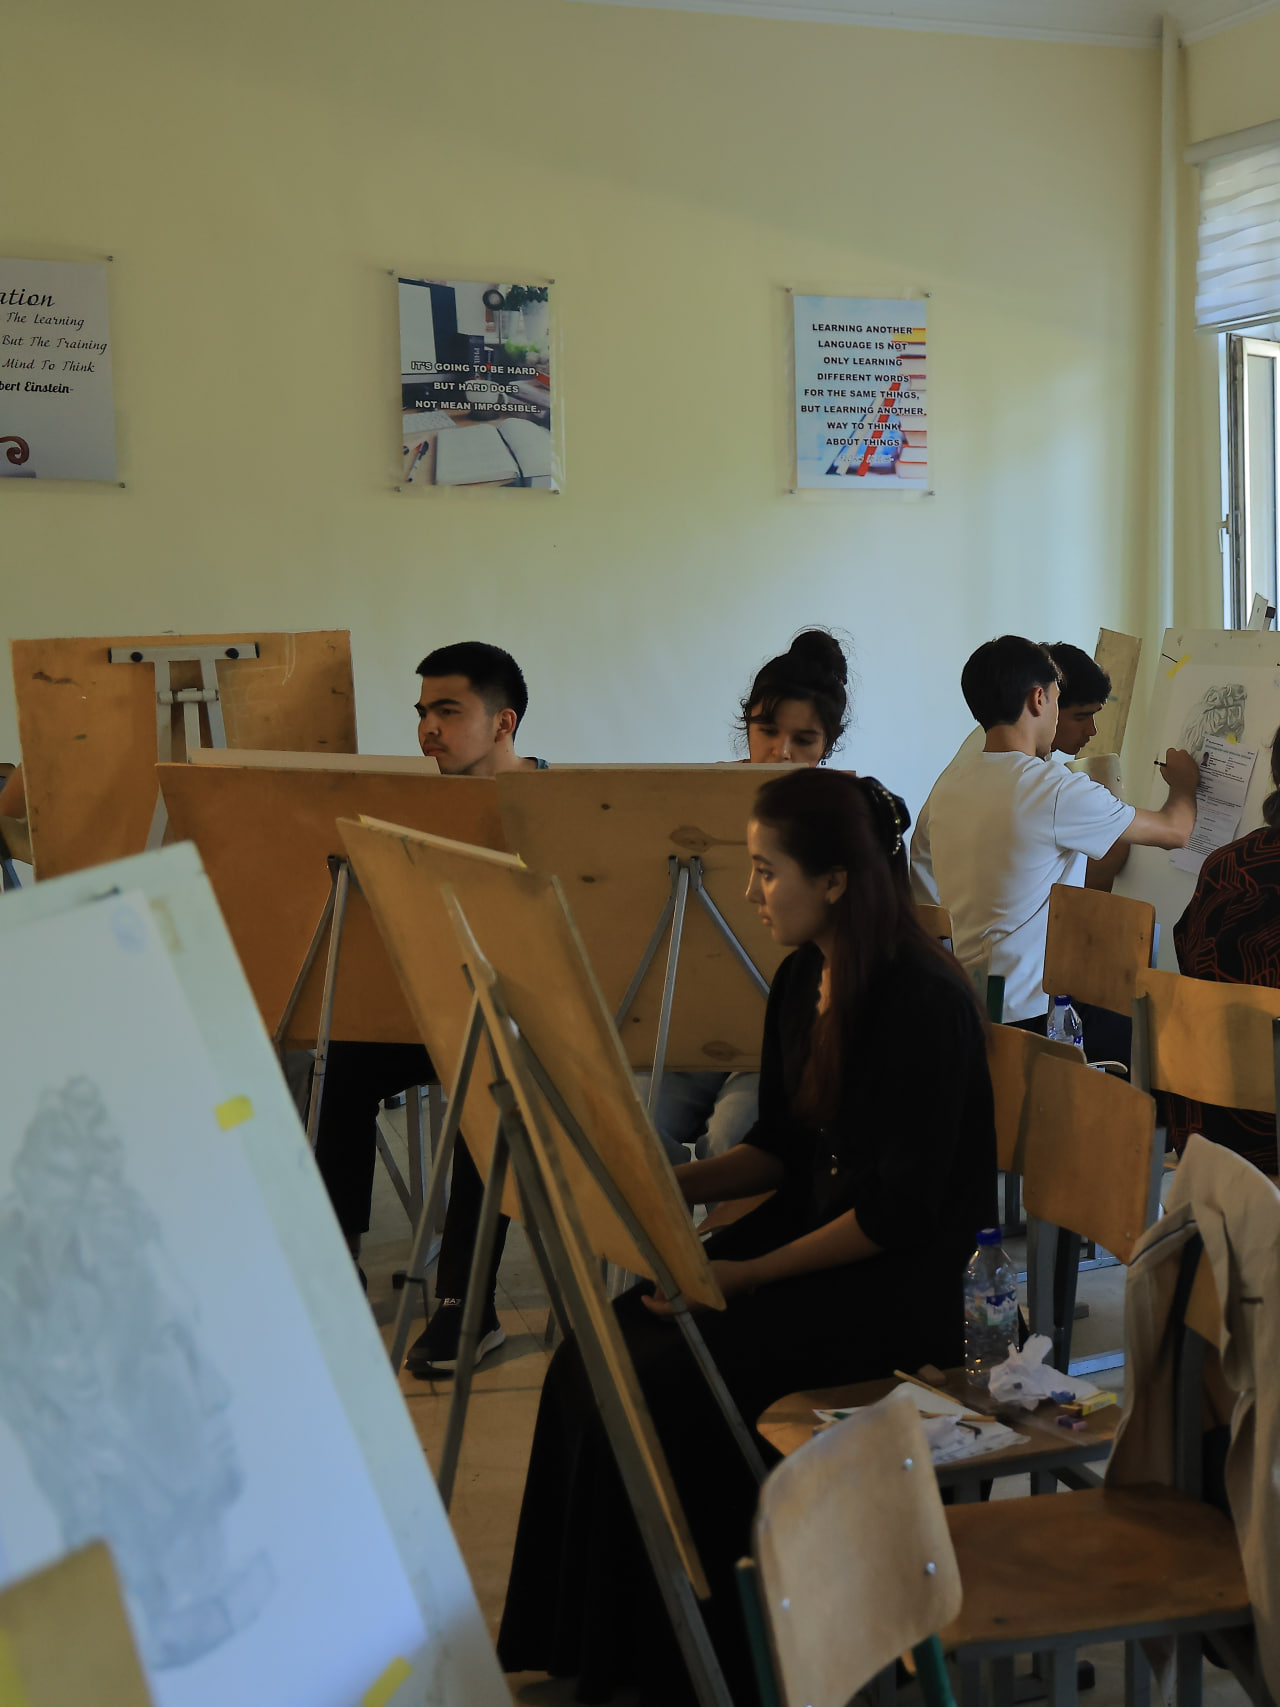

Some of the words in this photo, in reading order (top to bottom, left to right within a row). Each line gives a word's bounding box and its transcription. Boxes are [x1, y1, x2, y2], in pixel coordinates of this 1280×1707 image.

[7, 312, 27, 322] The
[34, 314, 84, 331] Learning
[812, 323, 863, 333] LEARNING
[866, 326, 912, 334] ANOTHER
[2, 335, 24, 345] But
[30, 337, 50, 347] The
[57, 338, 107, 355] Training
[818, 340, 872, 350] LANGUAGE
[875, 342, 884, 350] IS
[887, 342, 907, 351] NOT
[2, 359, 35, 369] Mind
[41, 360, 55, 370] To
[62, 361, 95, 372] Think
[823, 356, 849, 365] ONLY
[853, 358, 902, 366] LEARNING
[411, 361, 432, 370] IT'S
[435, 363, 470, 372] GOING
[473, 365, 487, 373] TO
[490, 366, 504, 374] BE
[507, 366, 539, 376] HARD,
[817, 372, 871, 382] DIFFERENT
[875, 374, 909, 383] WORDS
[434, 382, 455, 390] BUT
[458, 383, 488, 392] HARD
[491, 384, 519, 393] DOES
[804, 388, 824, 397] FOR
[827, 389, 846, 397] THE
[850, 390, 876, 399] SAME
[880, 391, 920, 400] THINGS,
[415, 400, 437, 409] NOT
[440, 401, 471, 410] MEAN
[474, 402, 540, 413] IMPOSSIBLE.
[801, 405, 821, 413] BUT
[824, 405, 874, 414] LEARNING
[877, 407, 923, 415] ANOTHER
[827, 422, 848, 430] WAY
[852, 422, 864, 430] TO
[868, 422, 899, 431] THINK
[826, 438, 860, 446] ABOUT
[863, 439, 900, 447] THINGS
